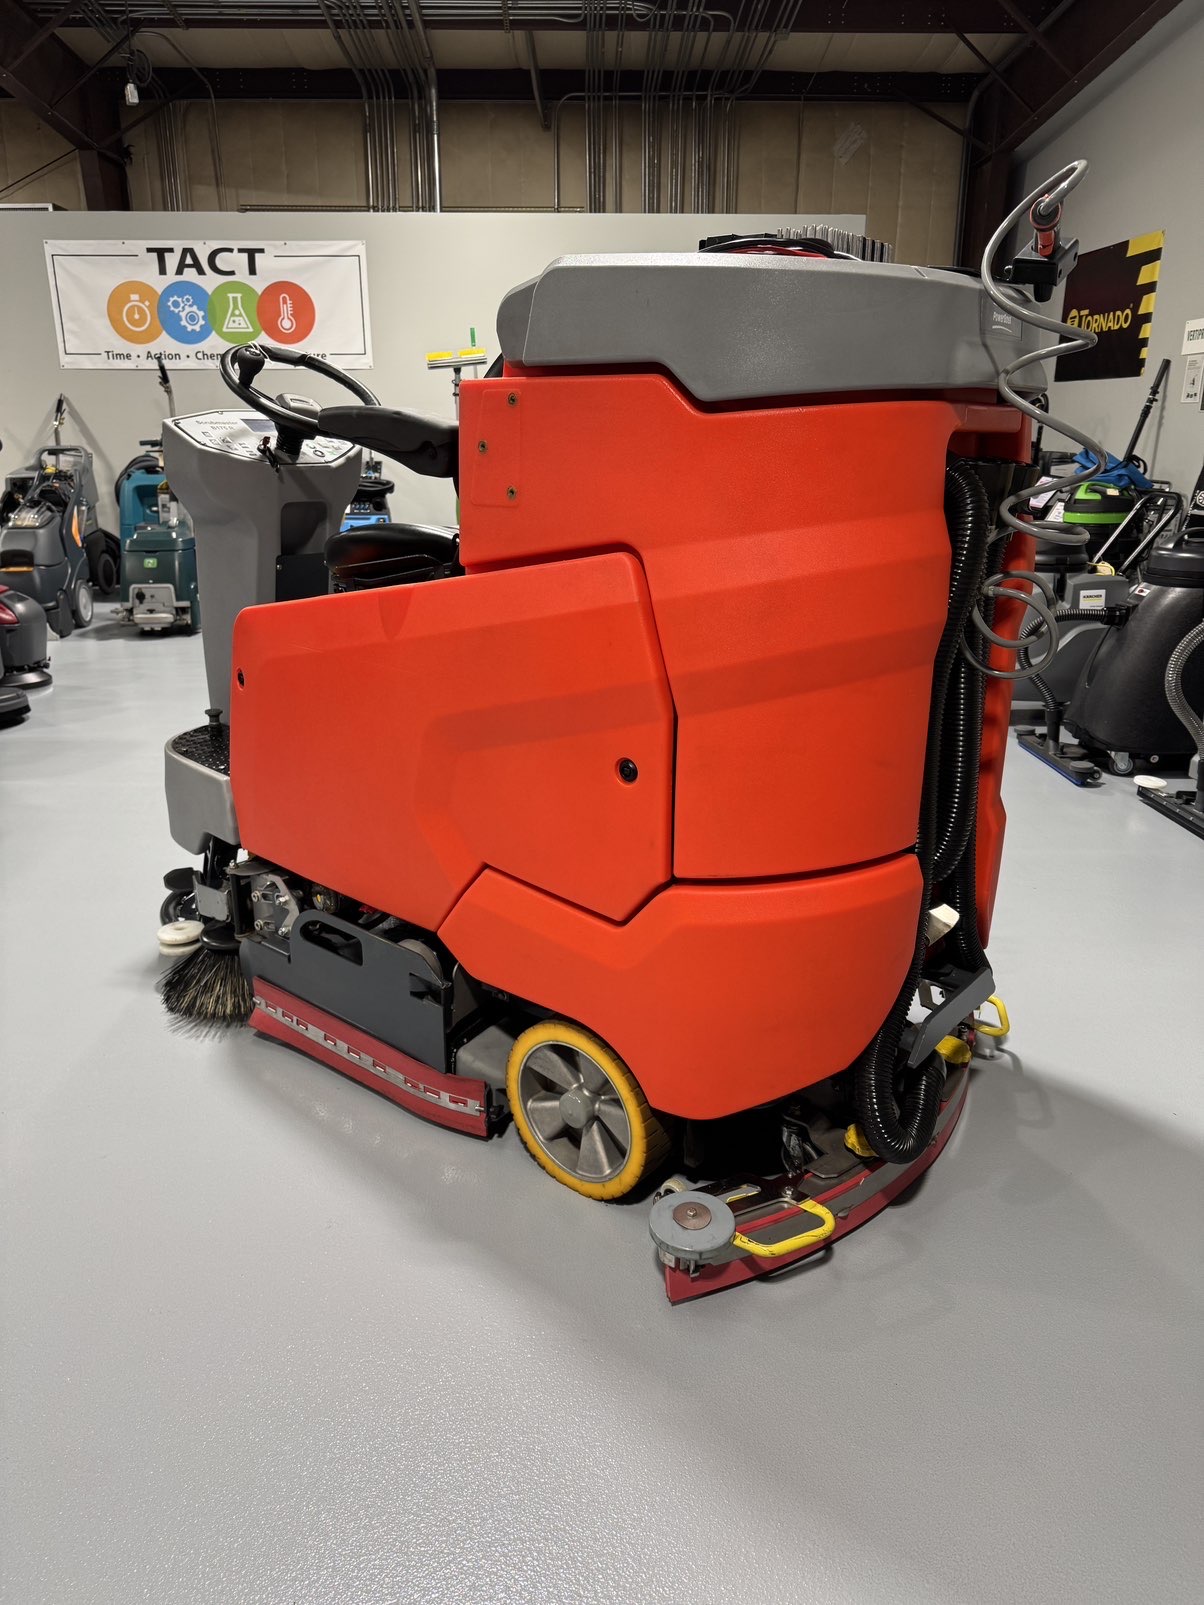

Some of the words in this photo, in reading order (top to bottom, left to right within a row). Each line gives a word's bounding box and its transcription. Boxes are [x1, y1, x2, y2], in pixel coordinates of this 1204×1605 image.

[146, 247, 265, 276] TACT
[1080, 308, 1132, 333] TORNADO
[104, 350, 132, 360] Time
[146, 350, 181, 360] Action
